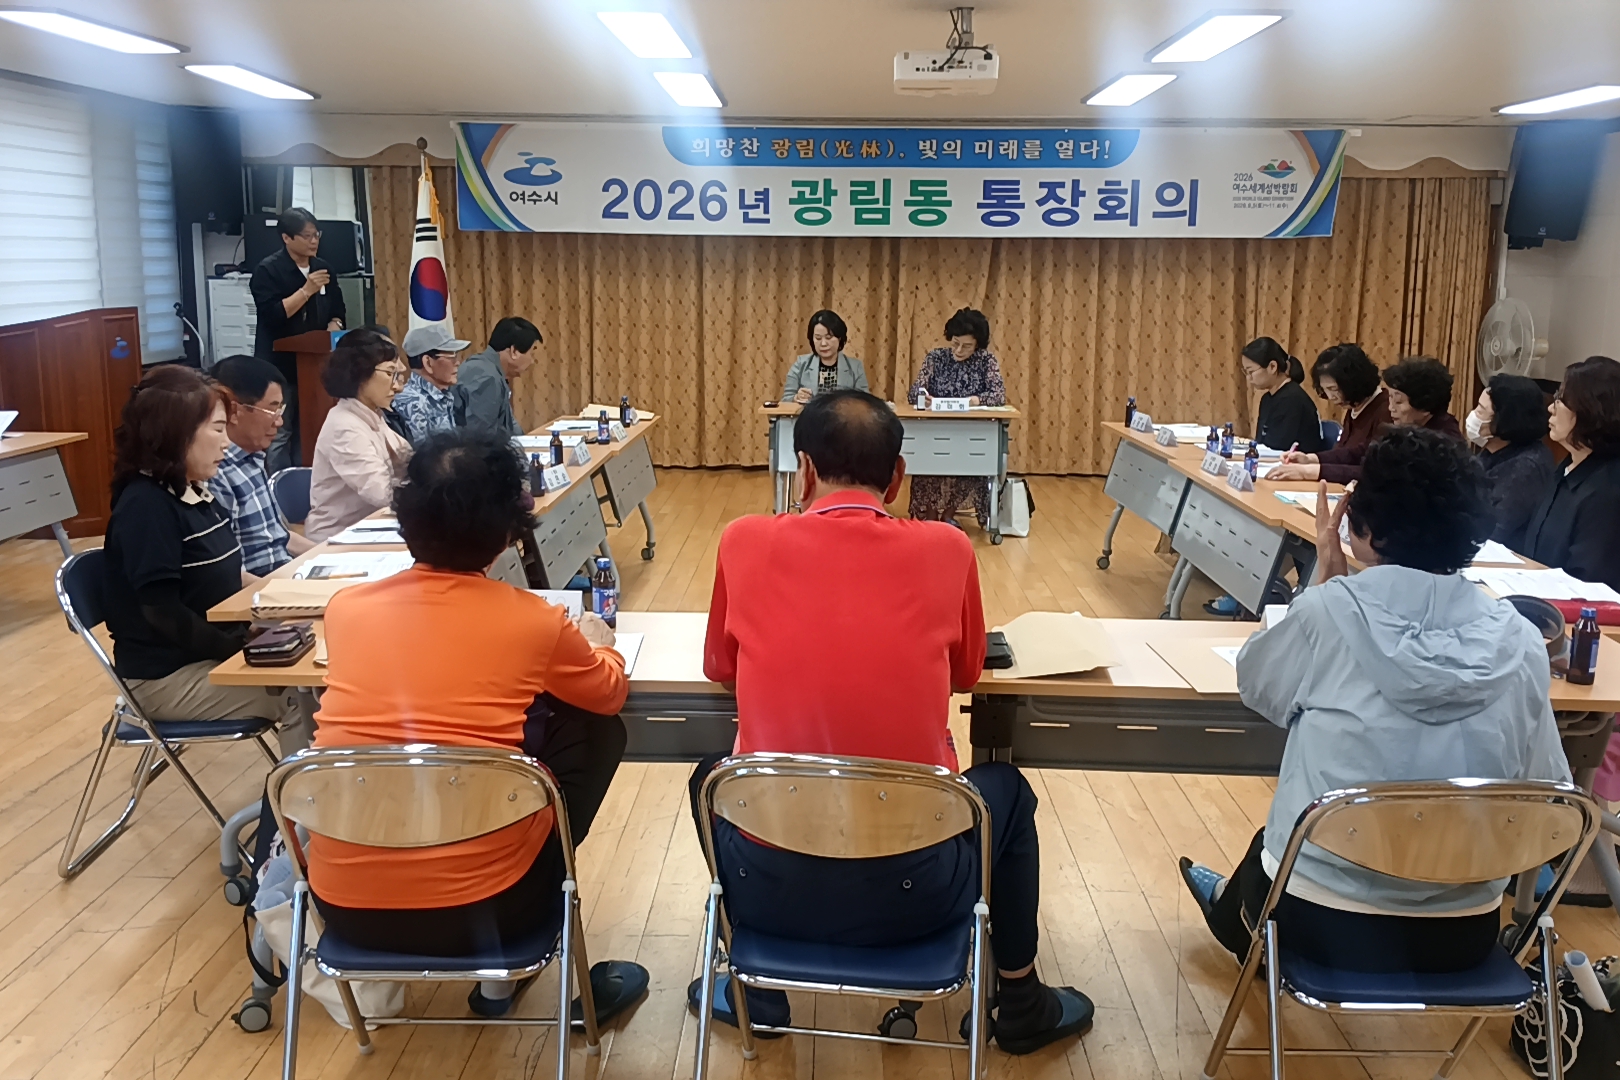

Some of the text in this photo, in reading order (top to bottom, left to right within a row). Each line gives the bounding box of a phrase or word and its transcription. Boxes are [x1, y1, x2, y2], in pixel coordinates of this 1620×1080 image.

[691, 138, 760, 159] 희망찬
[918, 139, 962, 160] 빛의
[974, 139, 1044, 161] 미래를
[1055, 139, 1111, 161] 열다!
[1233, 172, 1254, 182] 2026
[1232, 182, 1298, 195] 여수세계섬박람회
[508, 191, 559, 206] 여수시
[601, 178, 1199, 228] 2026년 광림동 통장회의
